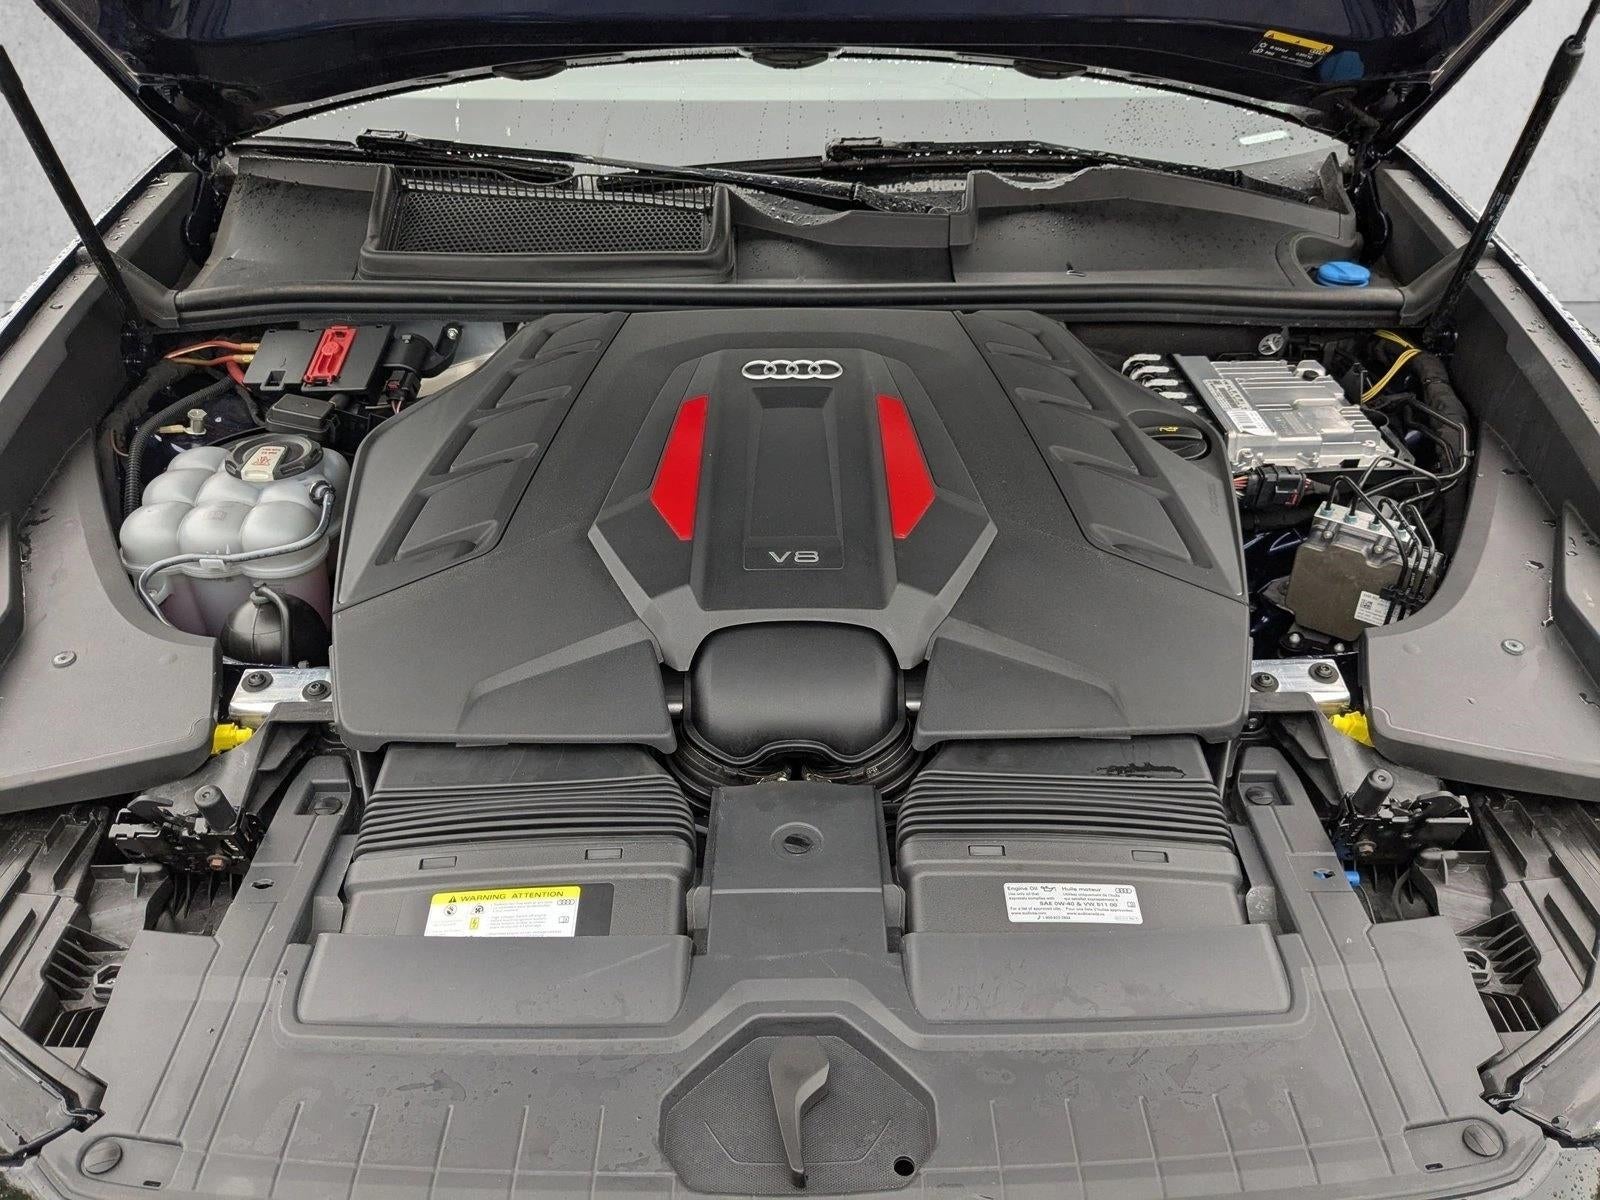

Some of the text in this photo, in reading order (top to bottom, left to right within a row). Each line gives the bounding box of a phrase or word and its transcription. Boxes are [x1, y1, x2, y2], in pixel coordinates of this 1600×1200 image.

[768, 550, 820, 563] V8
[1007, 885, 1028, 893] Engine
[460, 890, 564, 902] WARNING ATTENTION
